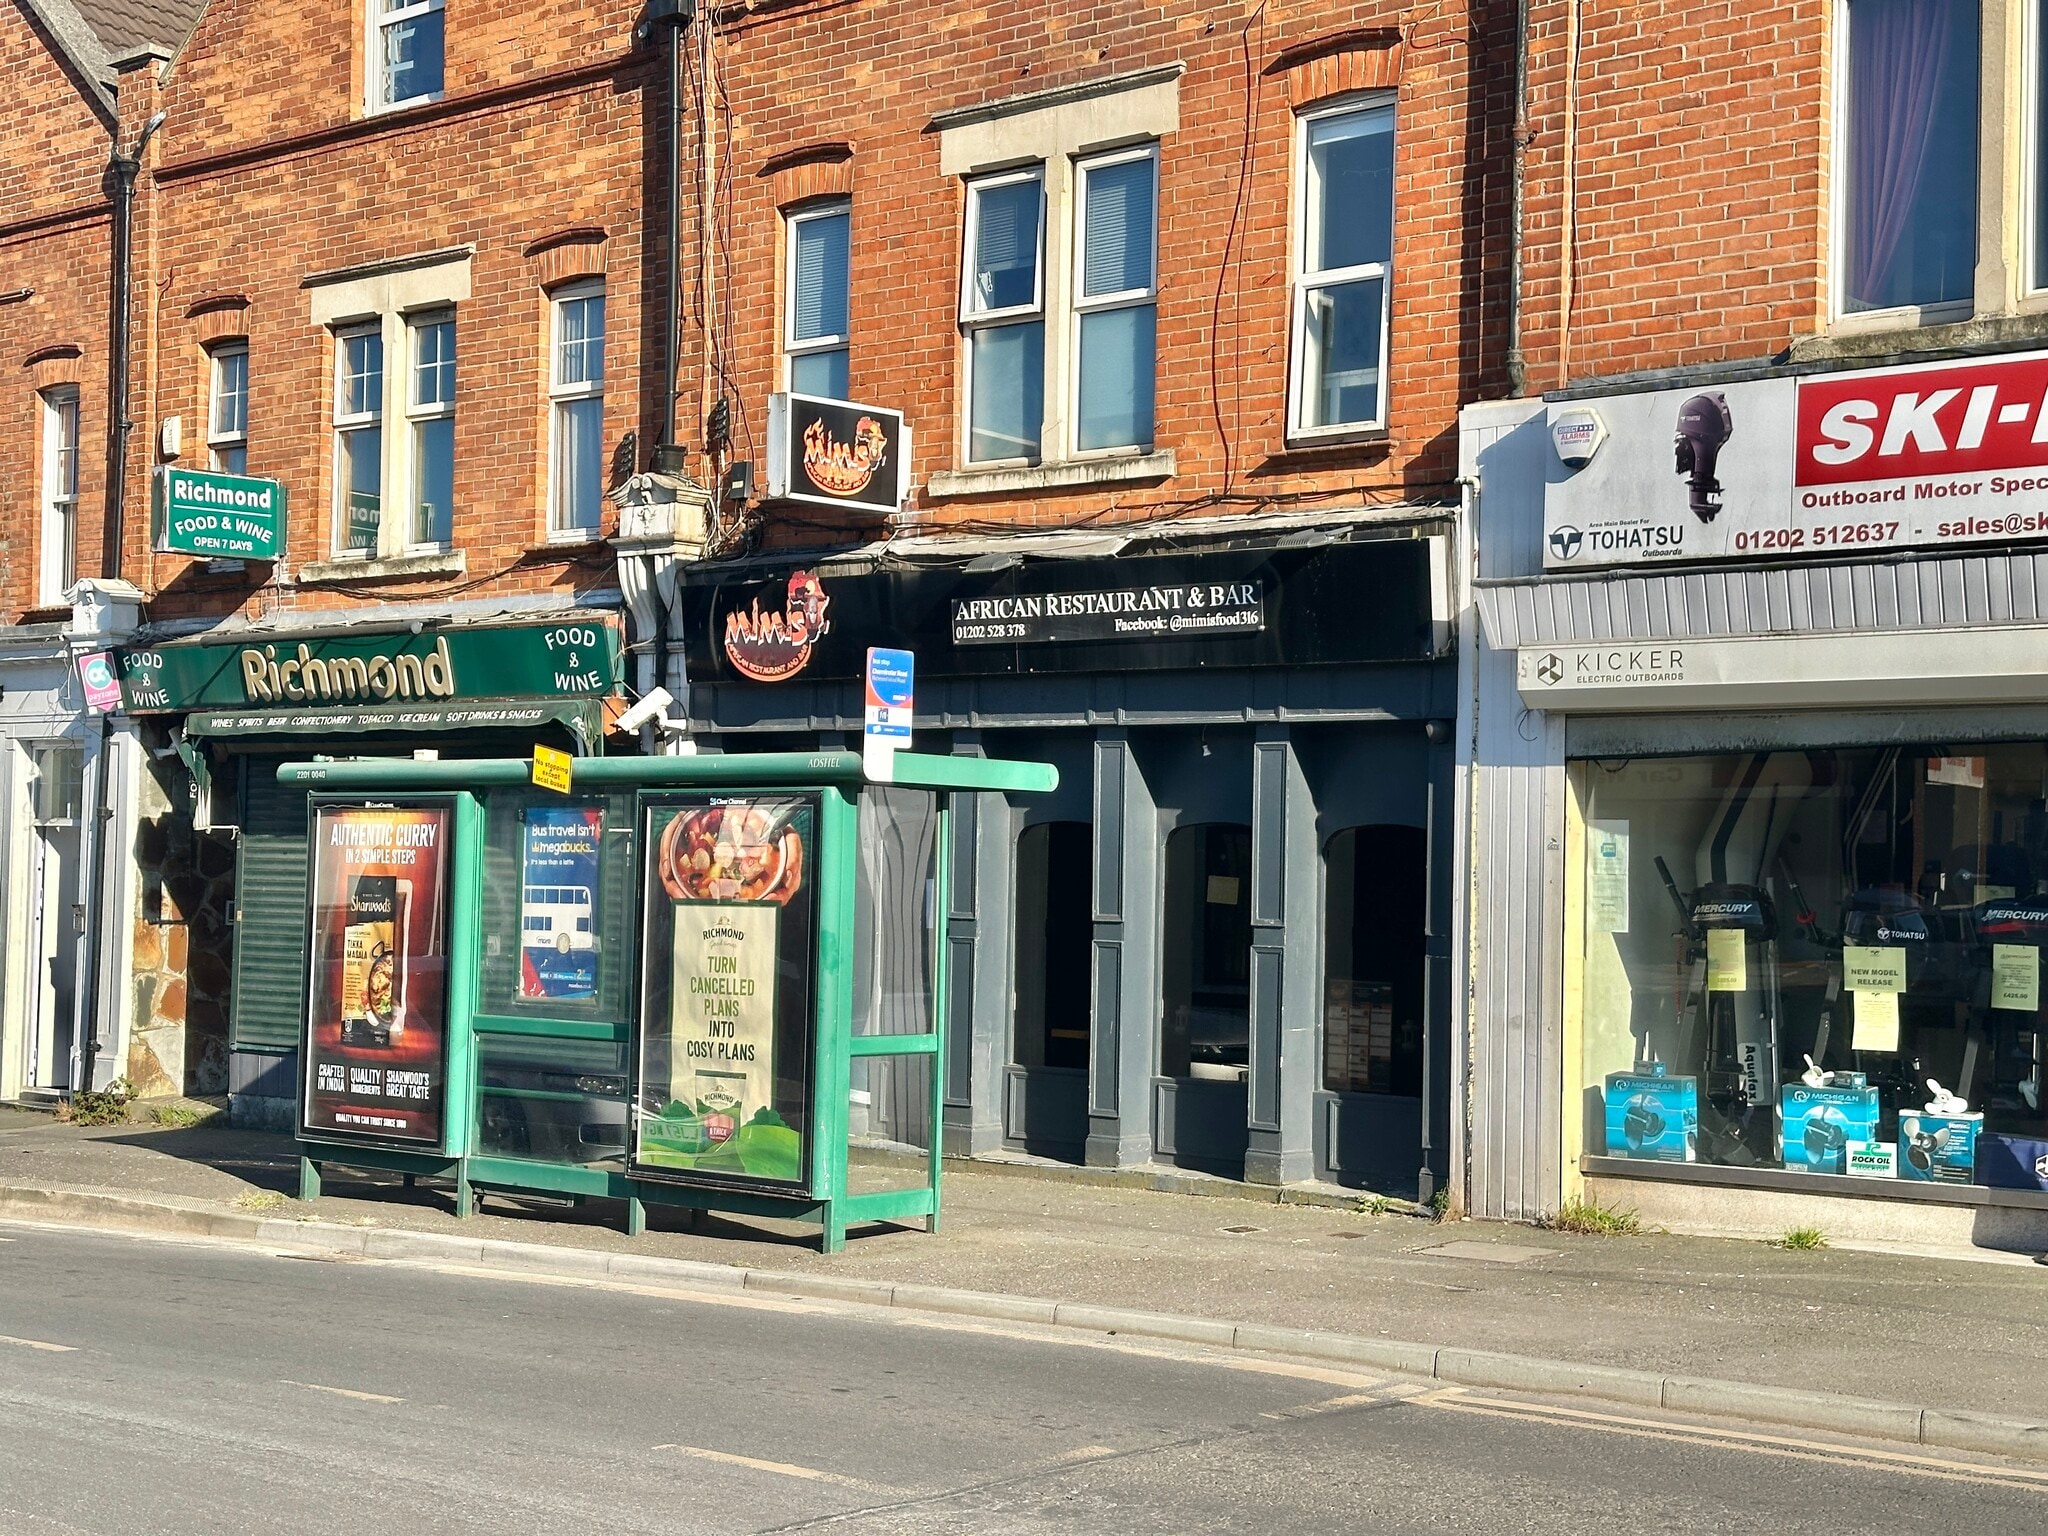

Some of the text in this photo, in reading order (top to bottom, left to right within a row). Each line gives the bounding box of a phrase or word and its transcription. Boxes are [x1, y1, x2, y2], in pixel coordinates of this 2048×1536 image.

[1812, 384, 2048, 466] SKI-
[1561, 432, 1590, 440] ALARMS
[174, 479, 272, 509] Richmond
[1802, 485, 1906, 509] Outboard
[1914, 481, 1983, 501] Motor
[174, 515, 273, 544] FOOD & WINE
[1619, 519, 1640, 527] Dealer
[193, 536, 253, 552] OPEN 7 DAYS
[1588, 525, 1684, 550] TOHATSU
[1735, 528, 1804, 550] 01202
[1812, 522, 1899, 545] 512637
[1642, 548, 1683, 558] Outboards
[956, 584, 1258, 621] AFRICAN RESTAURANT & BAR
[956, 623, 1026, 639] 01202 528 378
[1114, 617, 1168, 632] Facebook:
[544, 627, 596, 651] FOOD
[122, 652, 163, 671] FOOD
[569, 652, 579, 668] &
[727, 644, 808, 675] AFRICAN RESTAURANT AND BAR
[1576, 650, 1684, 672] KICKER
[241, 635, 455, 702] Richmond
[142, 672, 151, 686] &
[554, 670, 602, 692] WINE
[1576, 672, 1684, 683] ELECTRIC OUTBOARDS
[88, 689, 118, 702] payzone
[131, 688, 170, 707] WINE
[210, 718, 233, 728] WINES
[266, 716, 288, 726] BEER
[290, 715, 353, 726] CONFECTIONERY
[412, 712, 441, 723] CREAM
[446, 711, 468, 723] SOFT
[467, 711, 500, 722] DRINKS
[506, 709, 543, 720] SNACKS
[535, 758, 569, 775] No stopping
[807, 757, 841, 768] ADSHEL
[296, 770, 326, 779] 2201 0040
[536, 774, 566, 790] local buses
[330, 823, 437, 847] AUTHENTIC CURRY
[531, 823, 596, 836] Bus travel isn't
[345, 848, 416, 865] IN 2 SIMPLE STEPS
[1694, 903, 1753, 914] MERCURY
[1985, 909, 2048, 921] MERCURY
[702, 928, 745, 941] RICHMOND
[1891, 930, 1925, 940] TOHATSU
[707, 956, 737, 974] TURN
[690, 977, 755, 996] CANCELLED
[1857, 978, 1893, 986] RELEASE
[704, 999, 739, 1017] PLANS
[708, 1020, 735, 1038] INTO
[687, 1040, 755, 1061] COSY PLANS
[318, 1063, 345, 1078] CRAFTED
[350, 1067, 381, 1085] QUALITY
[386, 1069, 430, 1086] SHARWOOD'S
[1744, 1044, 1758, 1100] Aquafax
[317, 1076, 345, 1092] IN INDIA
[350, 1083, 381, 1096] INGREDIENTS
[386, 1084, 430, 1100] GREAT TASTE
[704, 1092, 734, 1103] RICHMOND
[1811, 1093, 1859, 1102] MICHIGAN
[335, 1113, 352, 1123] QUALITY
[1852, 1156, 1875, 1164] ROCK
